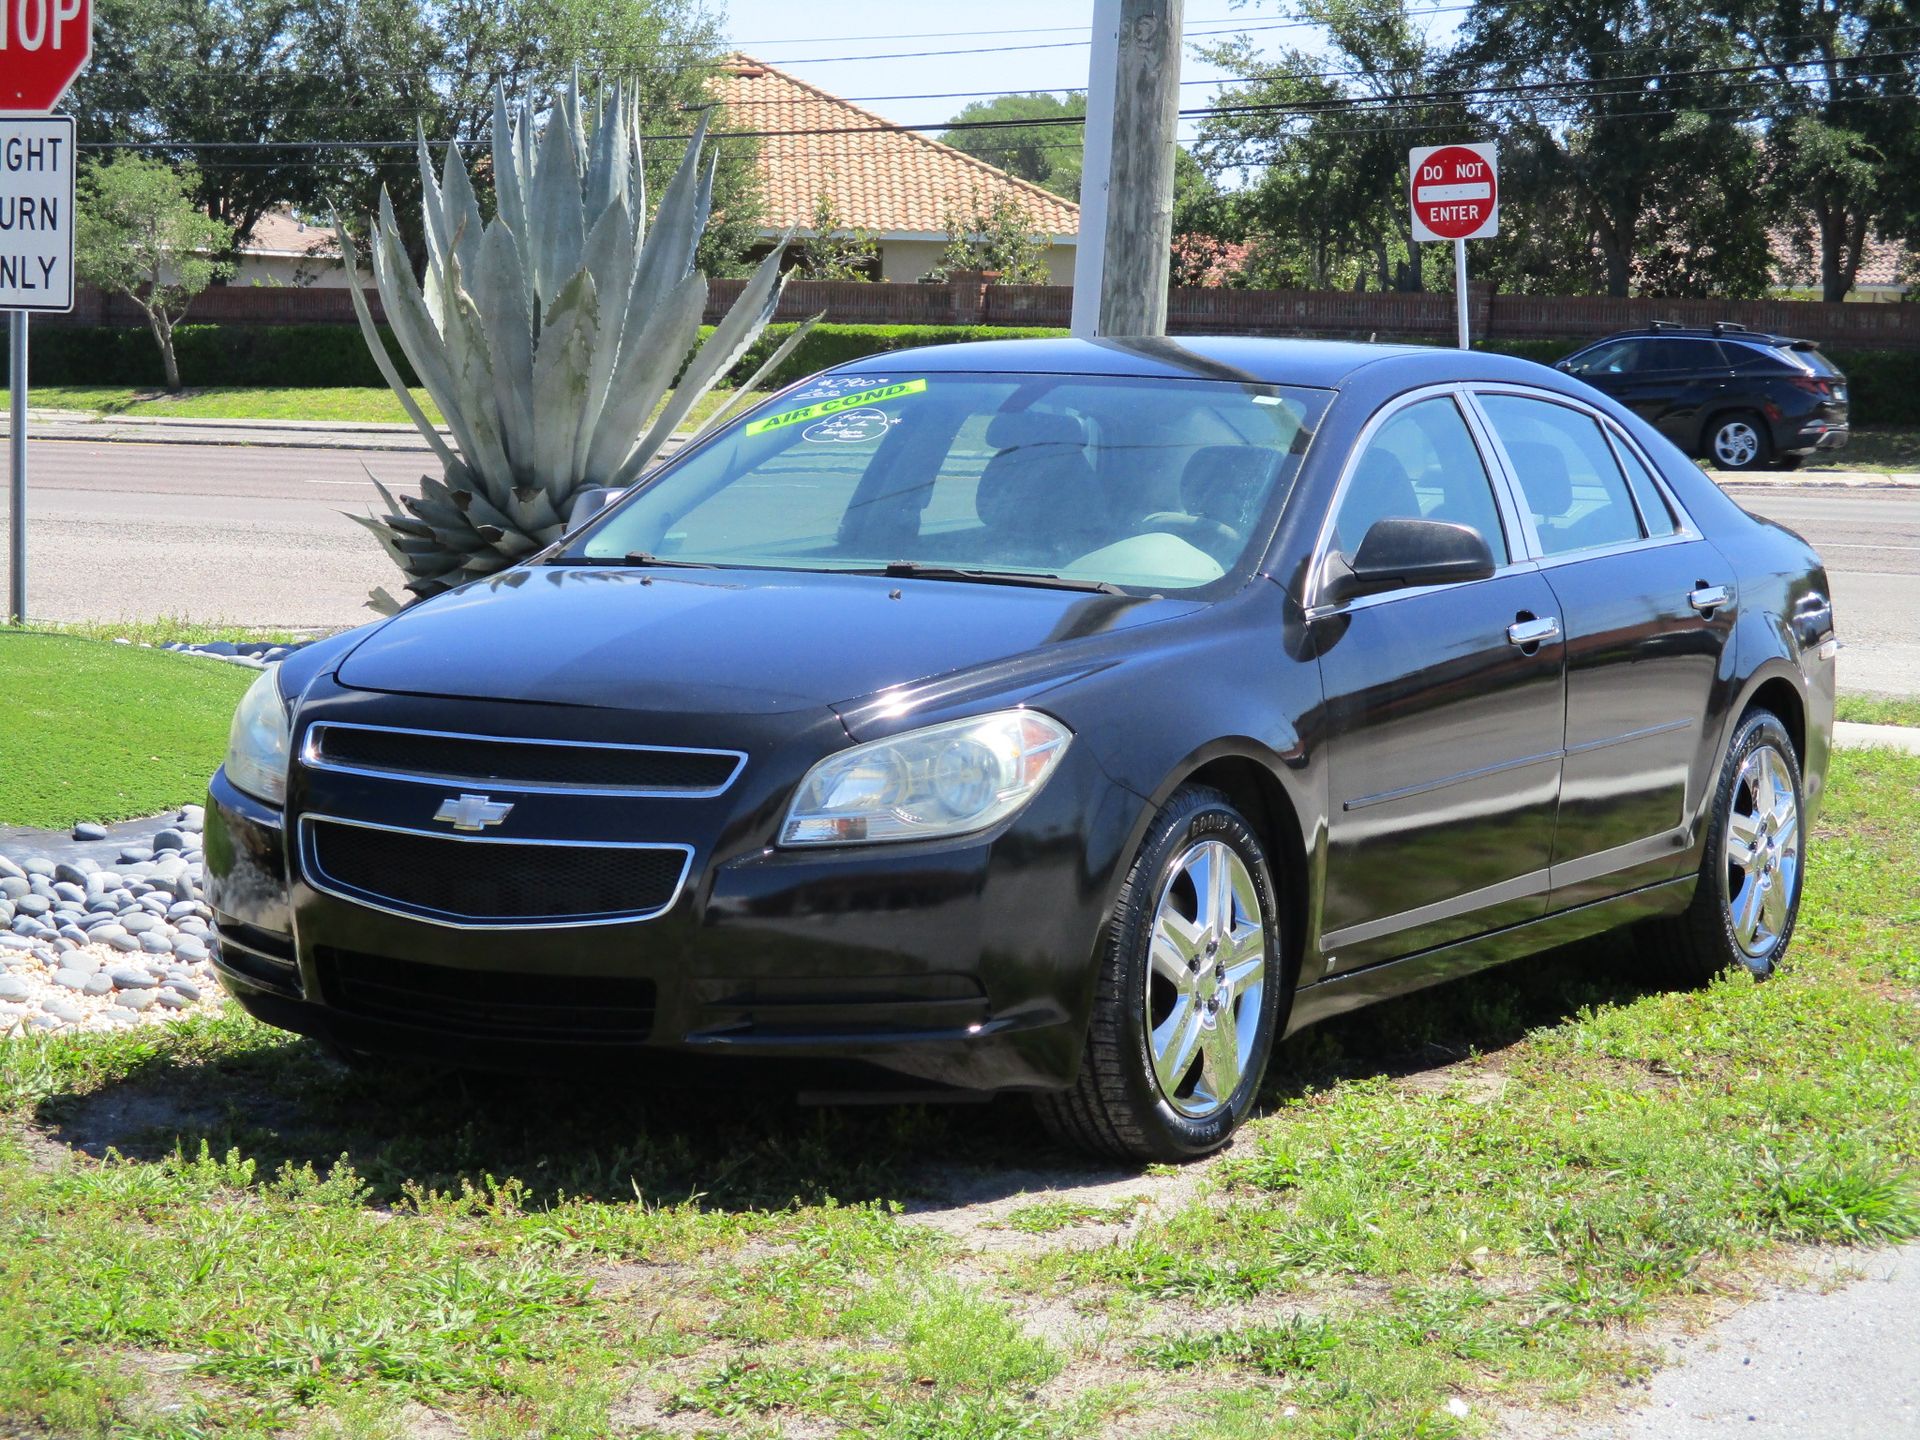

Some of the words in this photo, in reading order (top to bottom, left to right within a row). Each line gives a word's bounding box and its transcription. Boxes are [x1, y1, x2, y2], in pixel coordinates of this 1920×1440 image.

[1423, 165, 1443, 181] DO
[1456, 162, 1484, 178] NOT
[0, 197, 58, 231] URN
[1430, 205, 1479, 222] ENTER
[0, 255, 57, 290] NLY
[763, 408, 811, 428] AIR
[821, 385, 906, 412] COND
